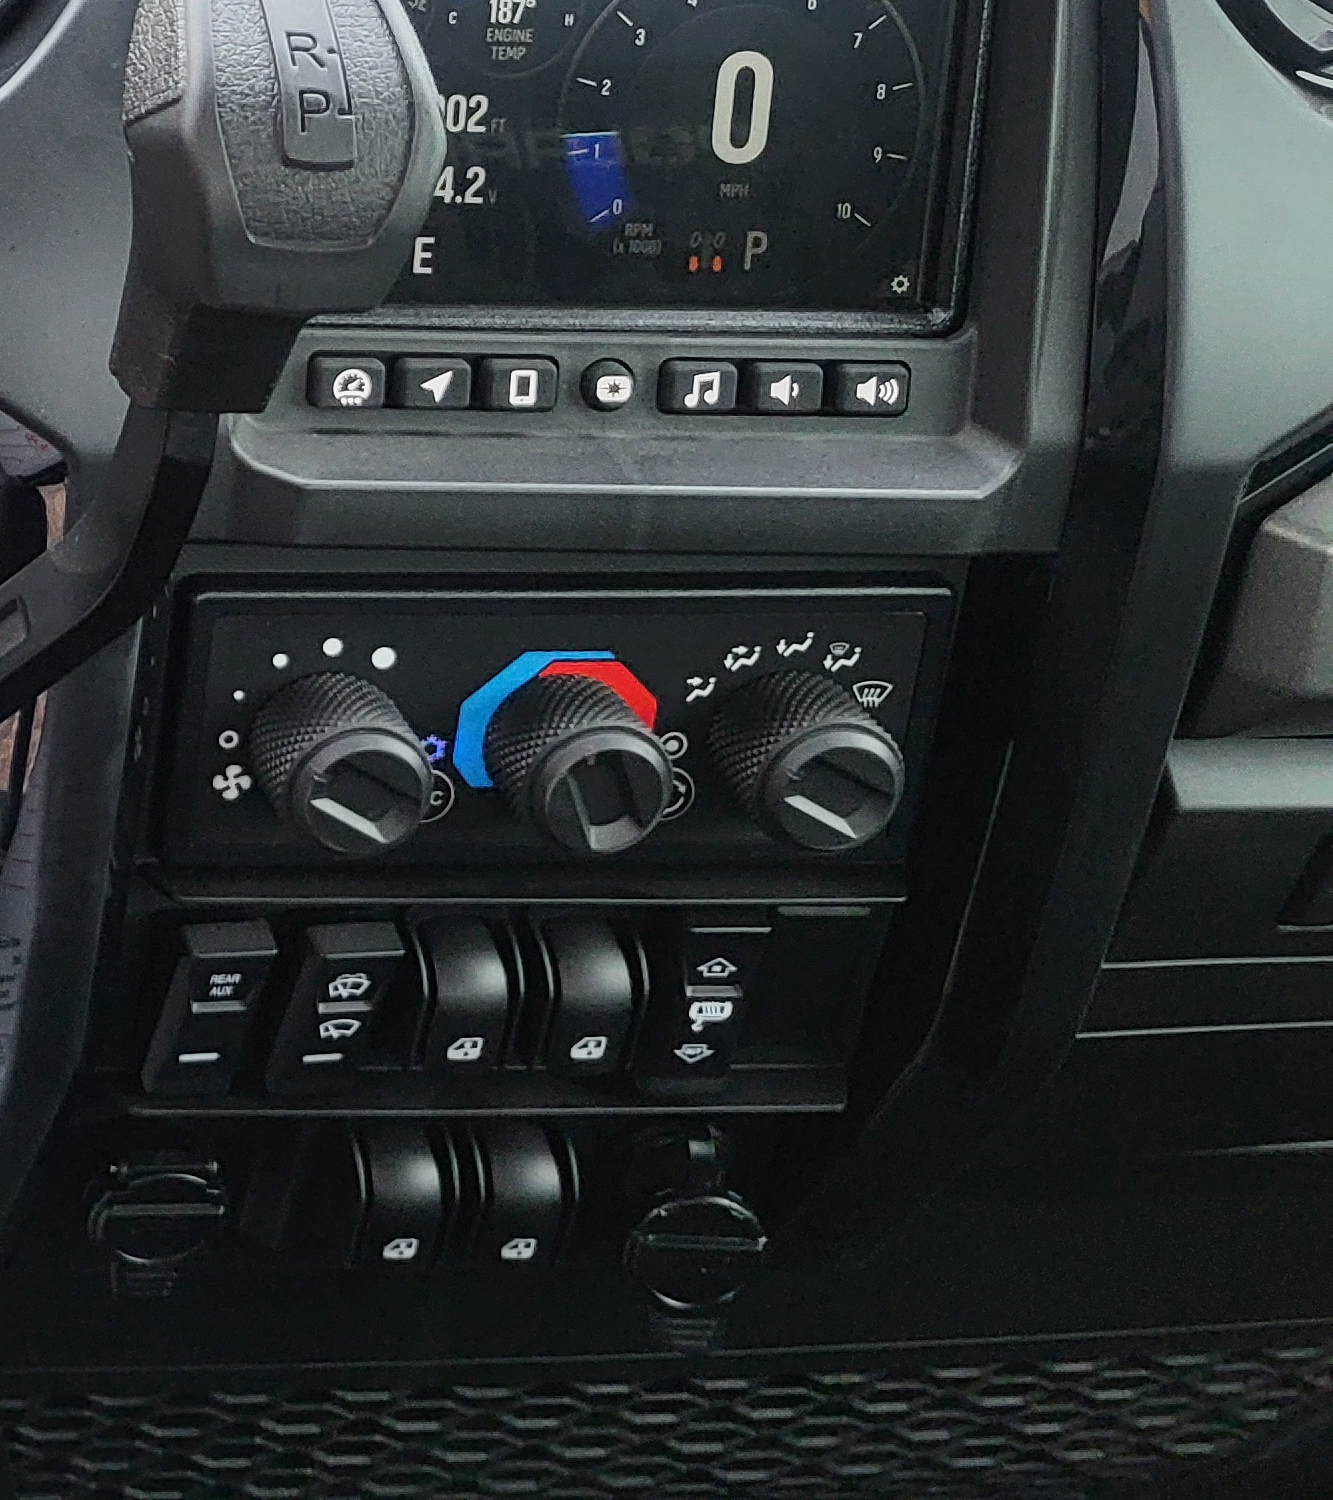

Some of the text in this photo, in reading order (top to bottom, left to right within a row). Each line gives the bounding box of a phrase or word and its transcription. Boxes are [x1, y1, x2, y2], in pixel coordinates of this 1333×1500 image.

[448, 11, 459, 26] C
[564, 12, 575, 27] H
[486, 28, 533, 44] ENGINE
[634, 28, 646, 47] 3
[853, 32, 863, 49] 7
[490, 46, 527, 61] TEMP
[600, 78, 612, 96] 2
[876, 83, 887, 100] 8
[439, 94, 490, 133] 02
[711, 50, 775, 165] 0
[593, 143, 601, 160] 1
[873, 146, 883, 164] 9
[433, 165, 487, 205] 4.2
[718, 183, 751, 199] MPH
[611, 198, 623, 216] 0
[836, 202, 852, 219] 10
[412, 236, 436, 275] E
[743, 230, 769, 271] P
[210, 973, 242, 986] REAR
[209, 985, 233, 998] AUX
